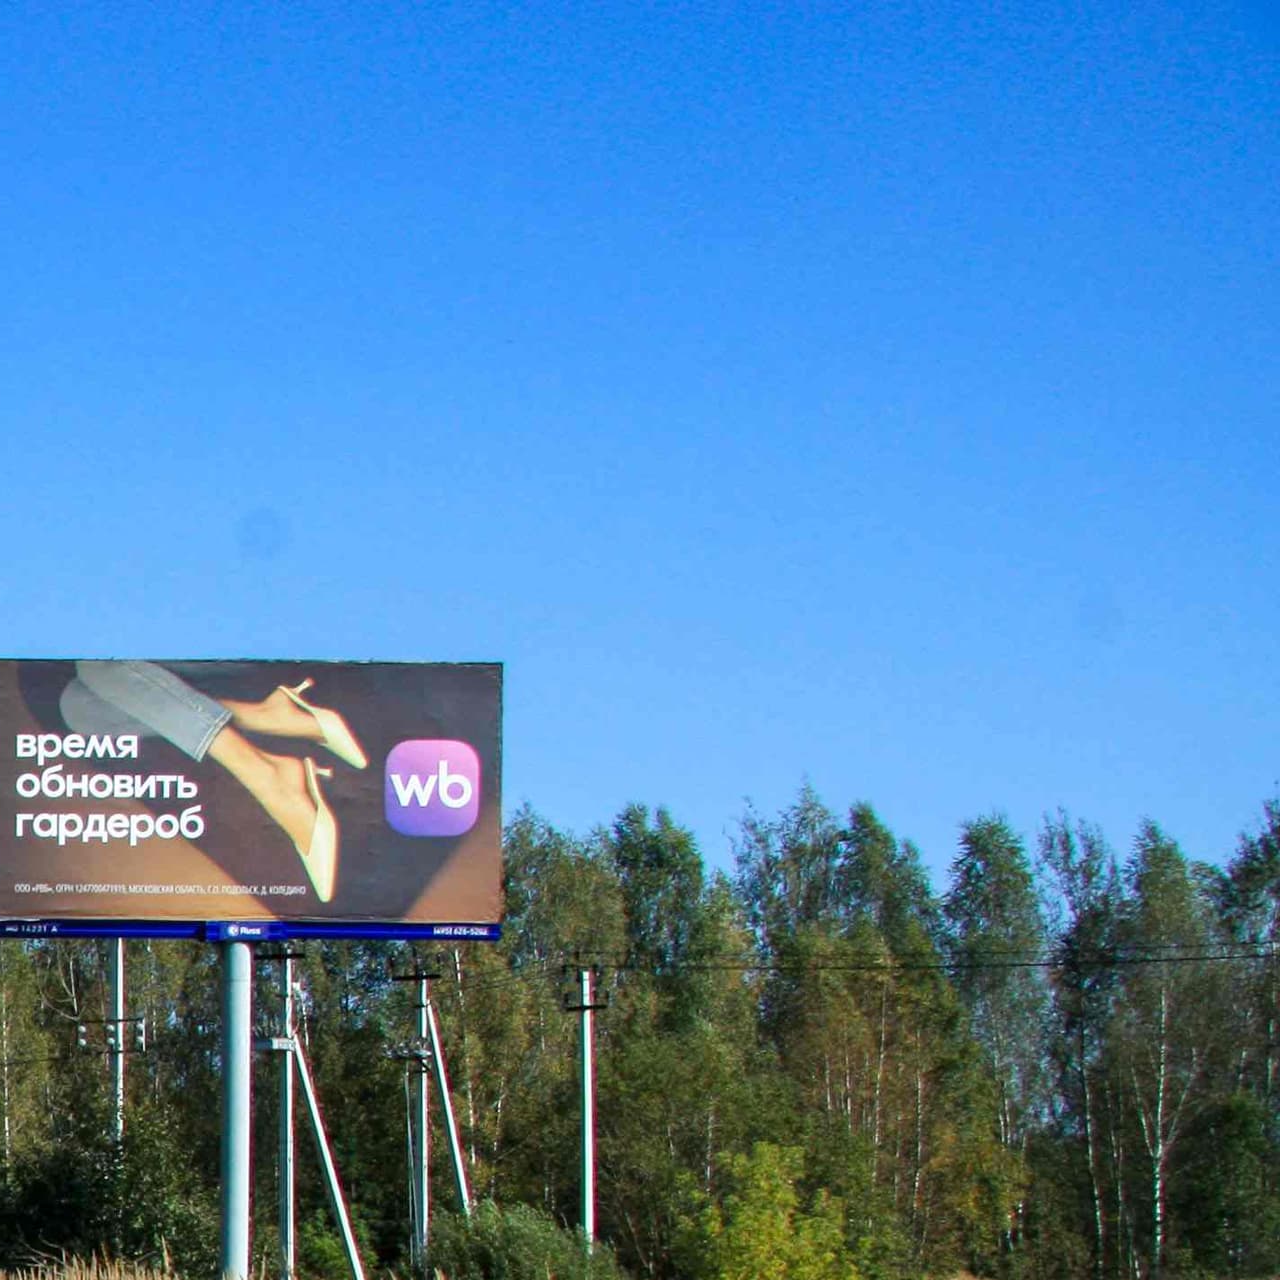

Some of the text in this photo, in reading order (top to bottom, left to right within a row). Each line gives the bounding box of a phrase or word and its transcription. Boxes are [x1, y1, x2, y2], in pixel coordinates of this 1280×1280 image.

[16, 734, 138, 766] время
[16, 764, 198, 798] обновить
[390, 760, 472, 808] wb
[16, 805, 205, 846] гардероб
[14, 883, 31, 893] ООО
